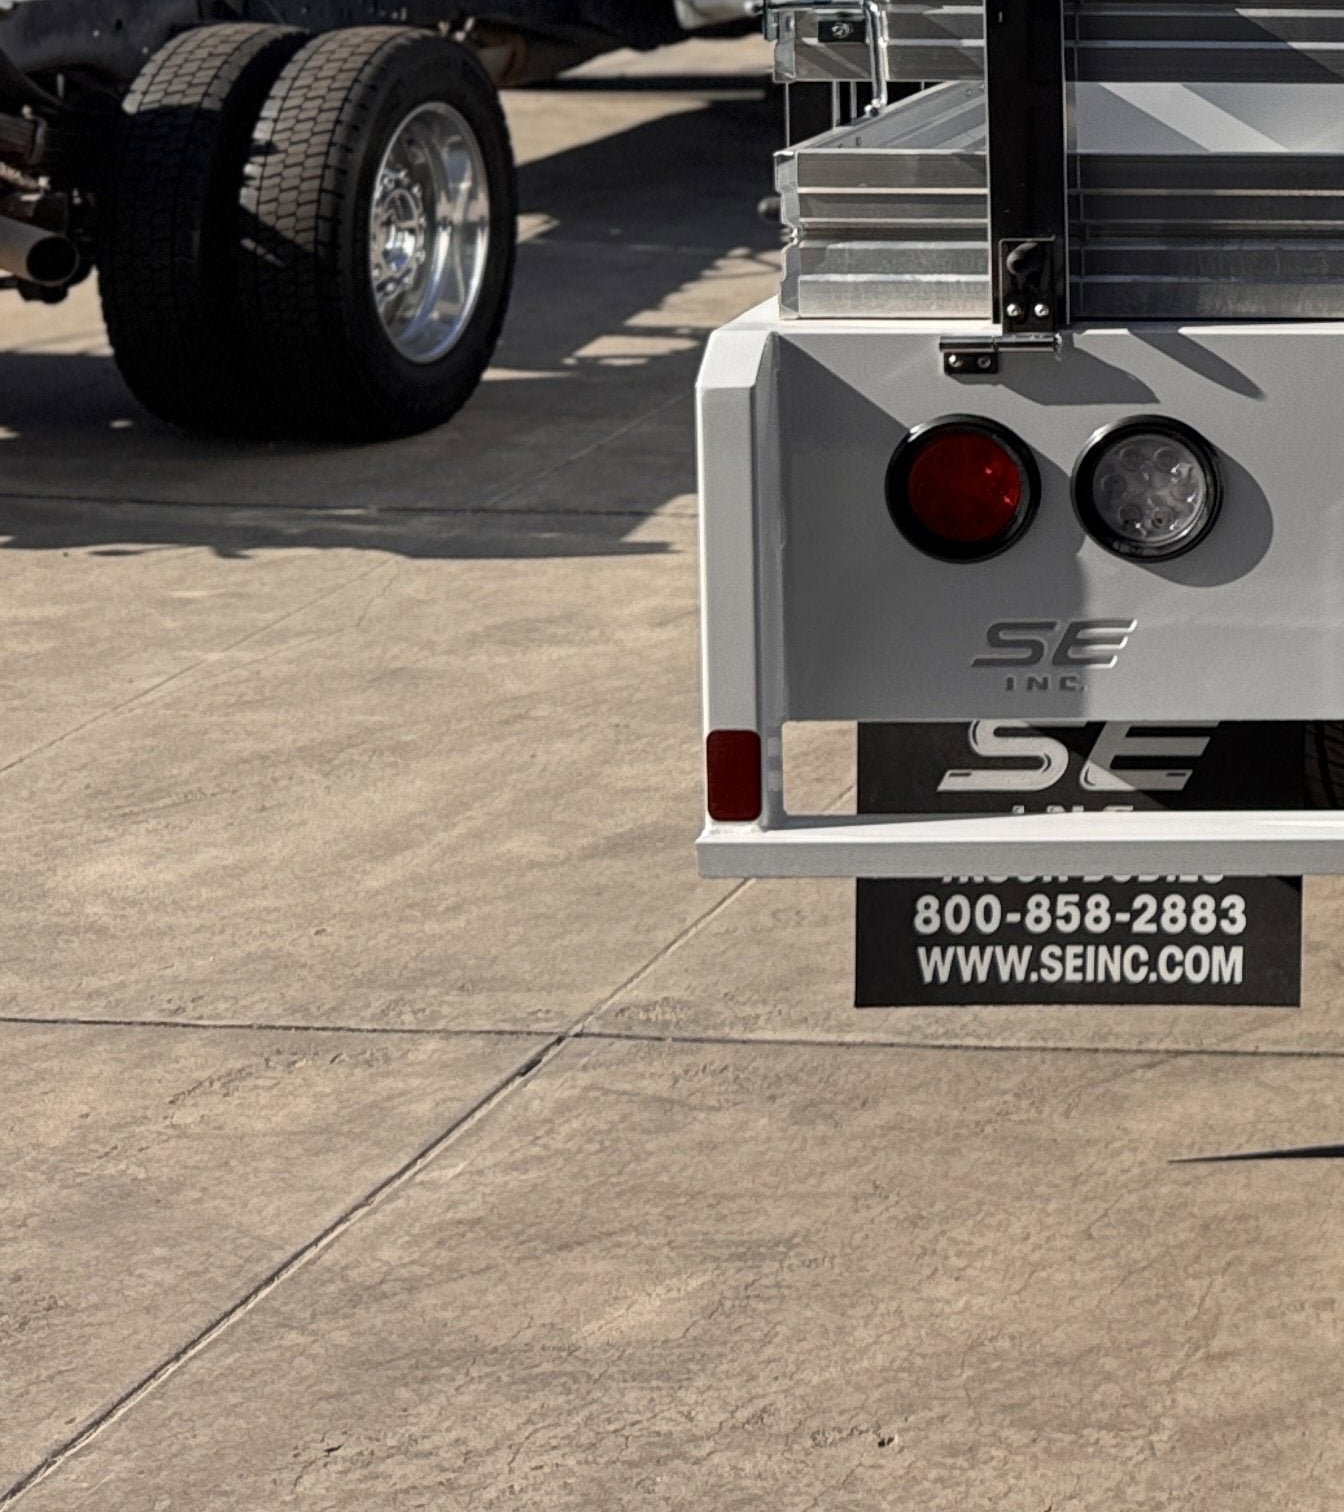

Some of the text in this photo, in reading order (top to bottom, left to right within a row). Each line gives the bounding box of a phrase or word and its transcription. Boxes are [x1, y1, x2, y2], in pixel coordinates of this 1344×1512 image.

[971, 618, 1138, 669] SE
[936, 721, 1220, 793] SE
[913, 893, 1247, 936] 800-858-2883
[916, 944, 1244, 984] WWW.SEINC.COM
